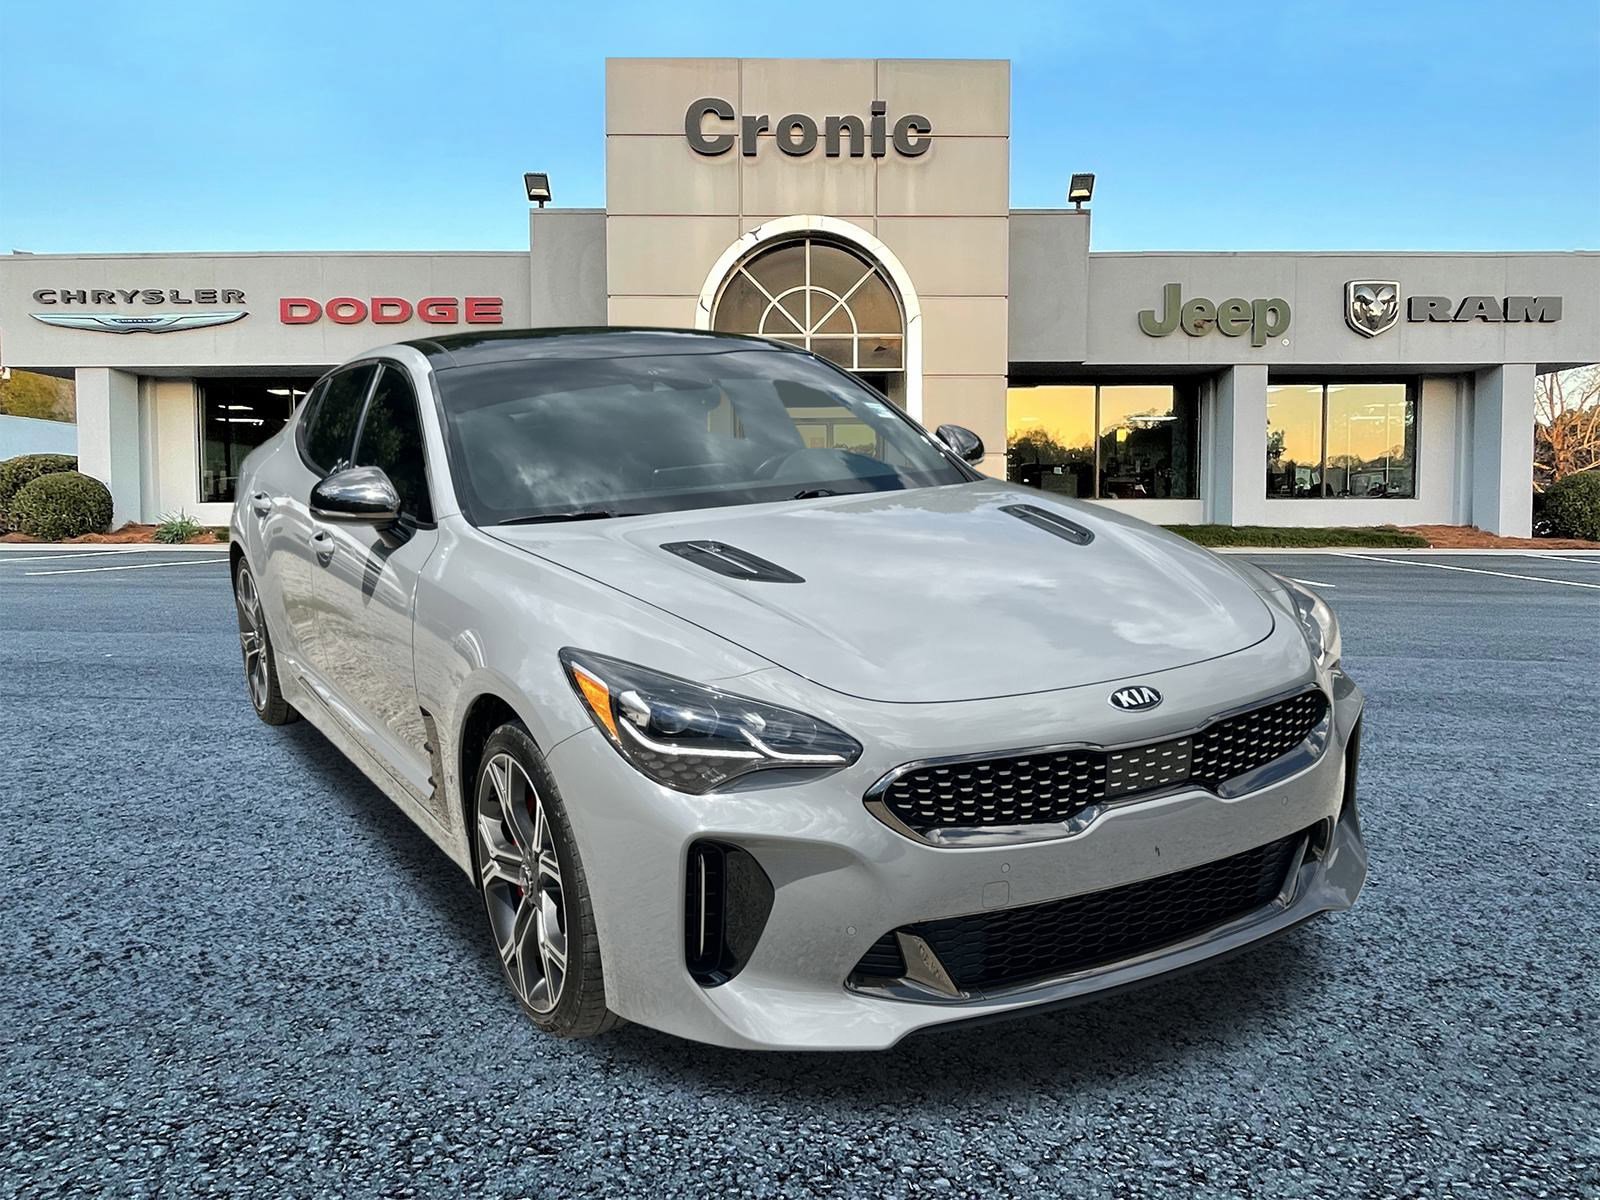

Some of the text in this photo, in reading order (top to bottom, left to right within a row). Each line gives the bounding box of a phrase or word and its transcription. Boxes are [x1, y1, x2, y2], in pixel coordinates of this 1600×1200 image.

[685, 97, 932, 157] Cronic
[33, 287, 247, 305] CHRYSLER
[1408, 296, 1563, 322] RAM
[280, 297, 503, 324] DODGE
[1138, 283, 1291, 346] Jeep
[1114, 687, 1158, 707] KIA
